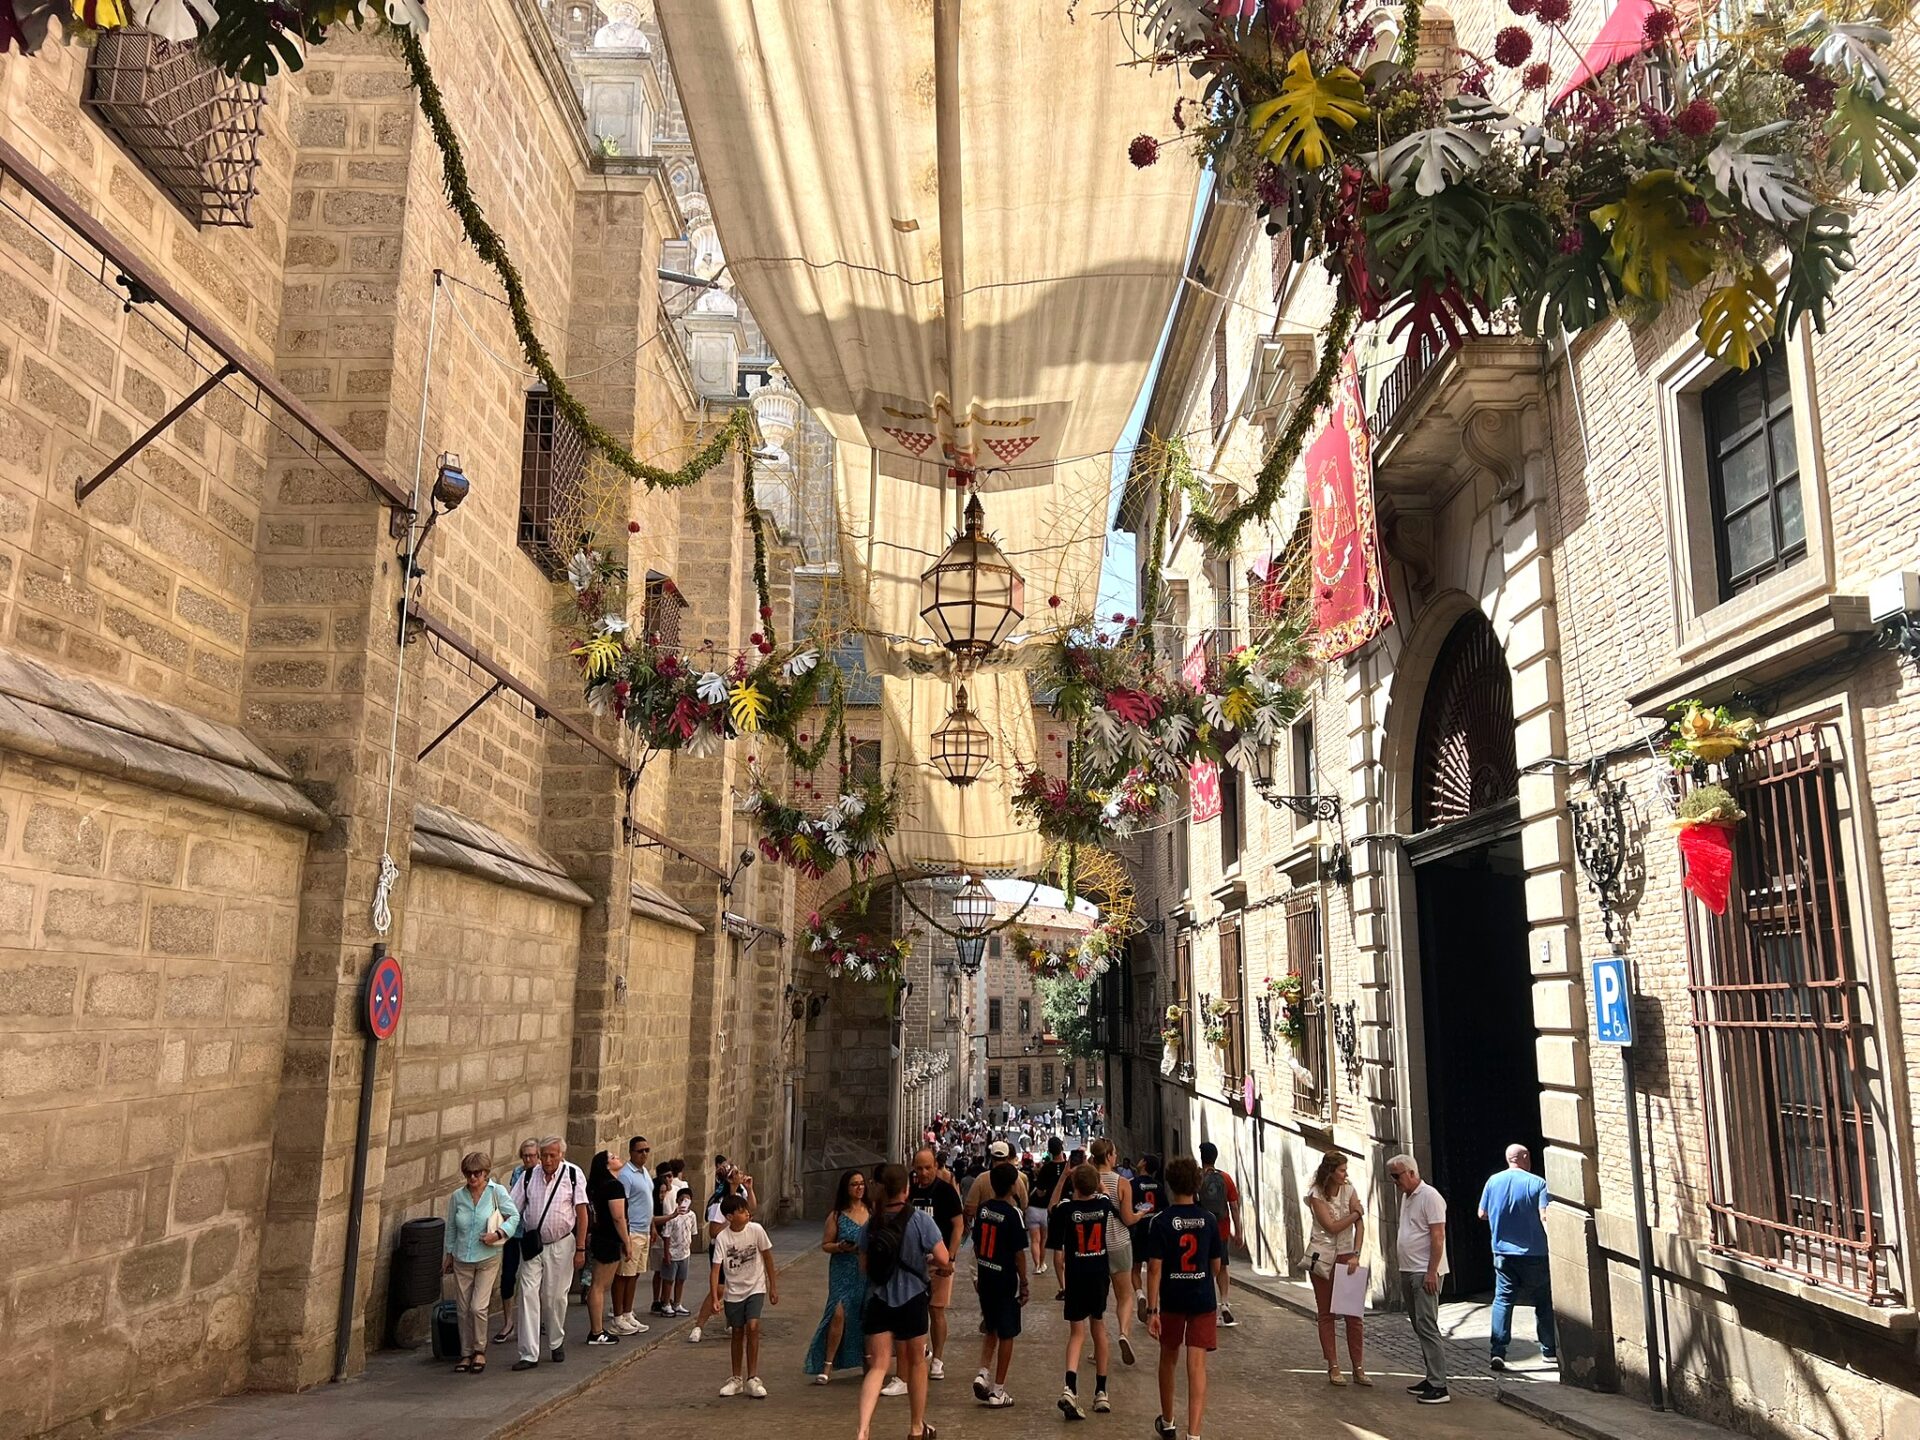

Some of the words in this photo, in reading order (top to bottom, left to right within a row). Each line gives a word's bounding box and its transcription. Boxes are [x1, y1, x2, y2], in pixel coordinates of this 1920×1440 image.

[1599, 965, 1619, 1023] P
[981, 1223, 996, 1258] 11
[1075, 1223, 1102, 1253] 14
[1179, 1233, 1197, 1271] 2
